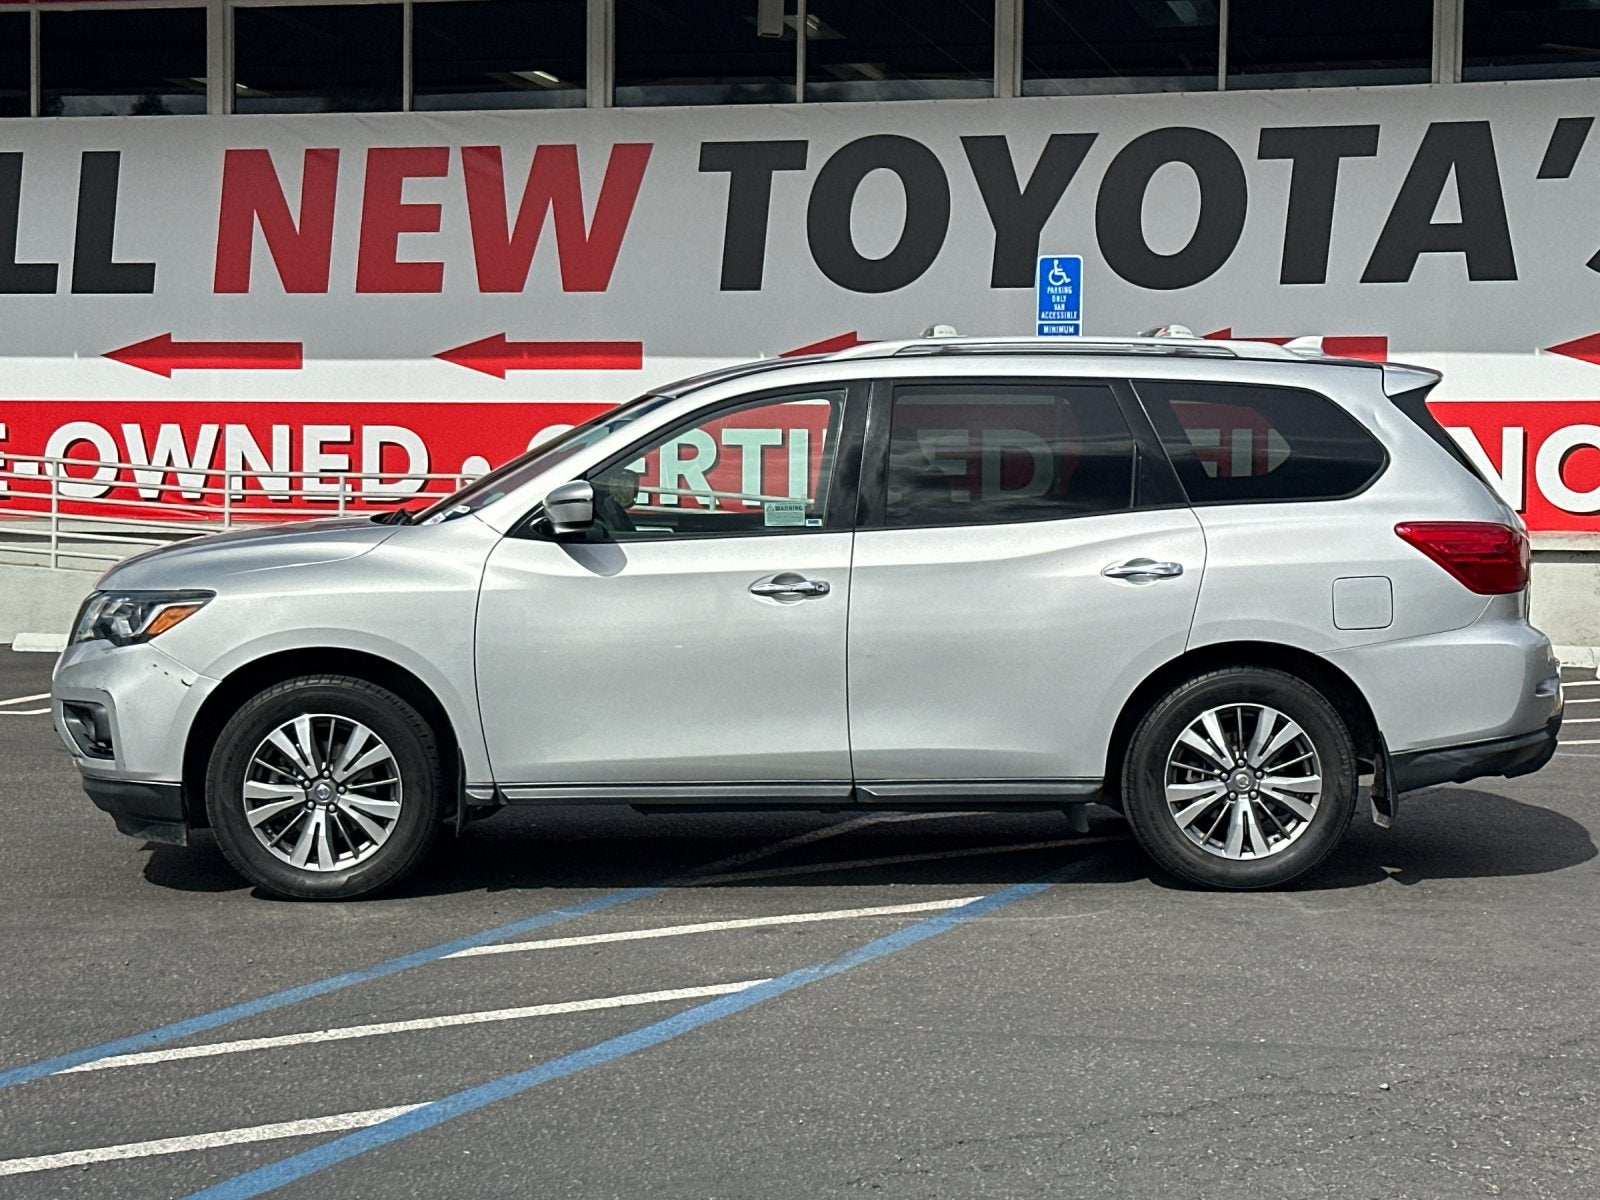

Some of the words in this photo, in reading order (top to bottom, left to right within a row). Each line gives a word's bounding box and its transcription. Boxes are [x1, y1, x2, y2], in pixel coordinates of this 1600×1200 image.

[212, 142, 654, 294] NEW
[699, 116, 1600, 294] TOYOTA'
[1047, 286, 1073, 294] PARKING
[1051, 295, 1067, 303] ONLY
[1053, 303, 1065, 311] VAN
[1041, 311, 1078, 319] ACCESSIBLE
[1043, 325, 1075, 334] MINIMUM
[0, 421, 430, 501] -OWNED
